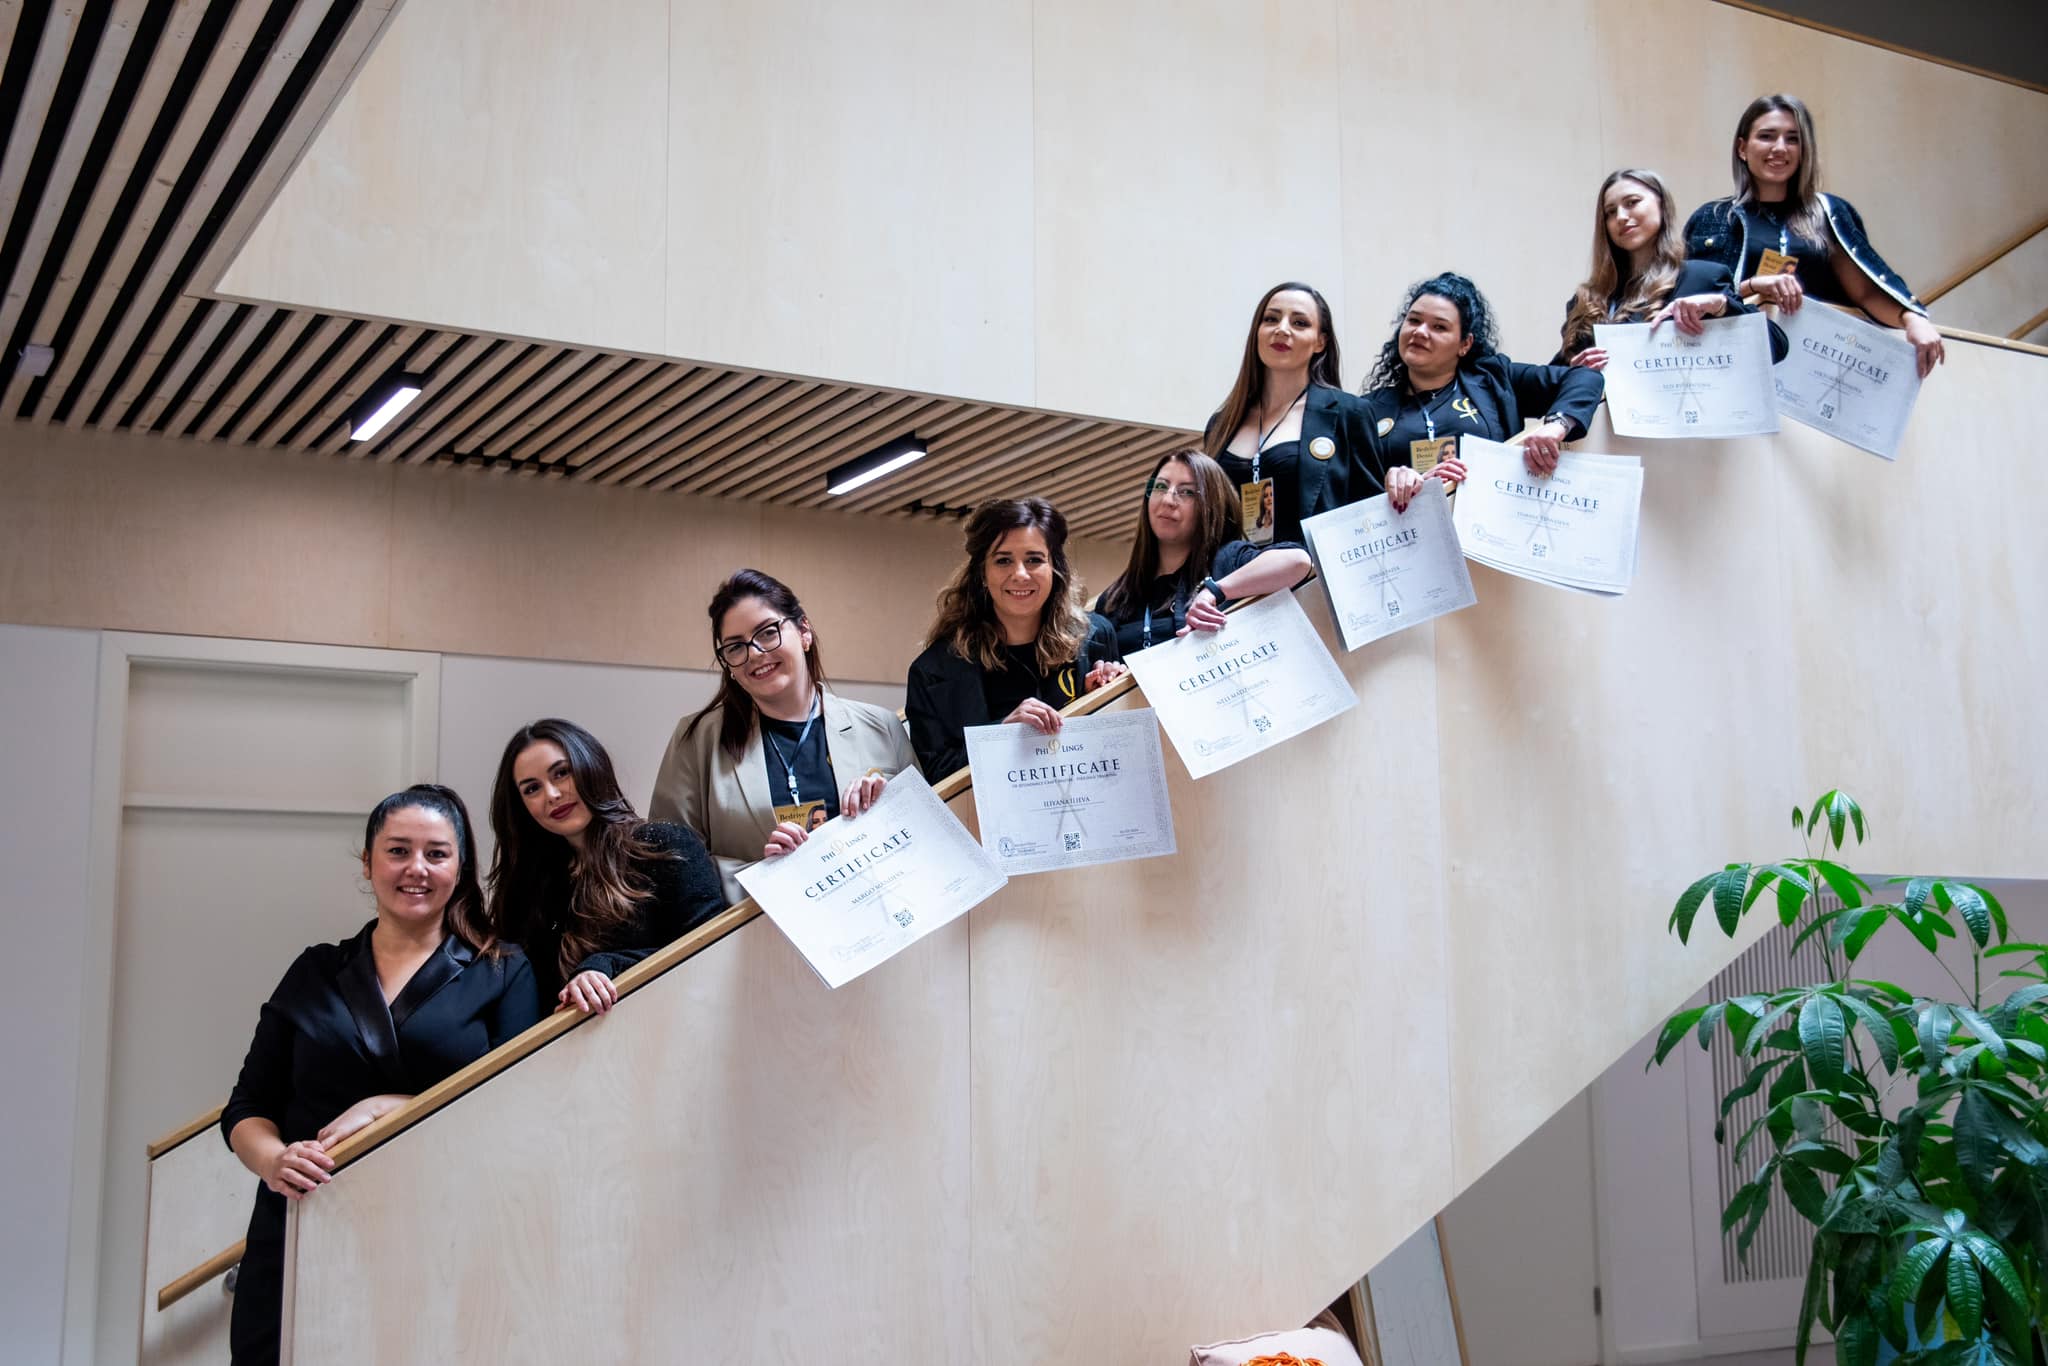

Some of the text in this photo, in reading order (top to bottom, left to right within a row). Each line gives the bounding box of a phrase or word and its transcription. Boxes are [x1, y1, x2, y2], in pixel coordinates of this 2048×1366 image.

[1633, 354, 1734, 370] CERTIFICATE
[1803, 337, 1889, 383] CERTIFICATE
[1494, 479, 1600, 510] CERTIFICATE
[1339, 528, 1419, 564] CERTIFICATE
[1178, 640, 1279, 692] CERTIFICATE
[1035, 744, 1084, 756] PHI LINGS
[1007, 758, 1121, 783] CERTIFICATE
[804, 827, 913, 899] CERTIFICATE
